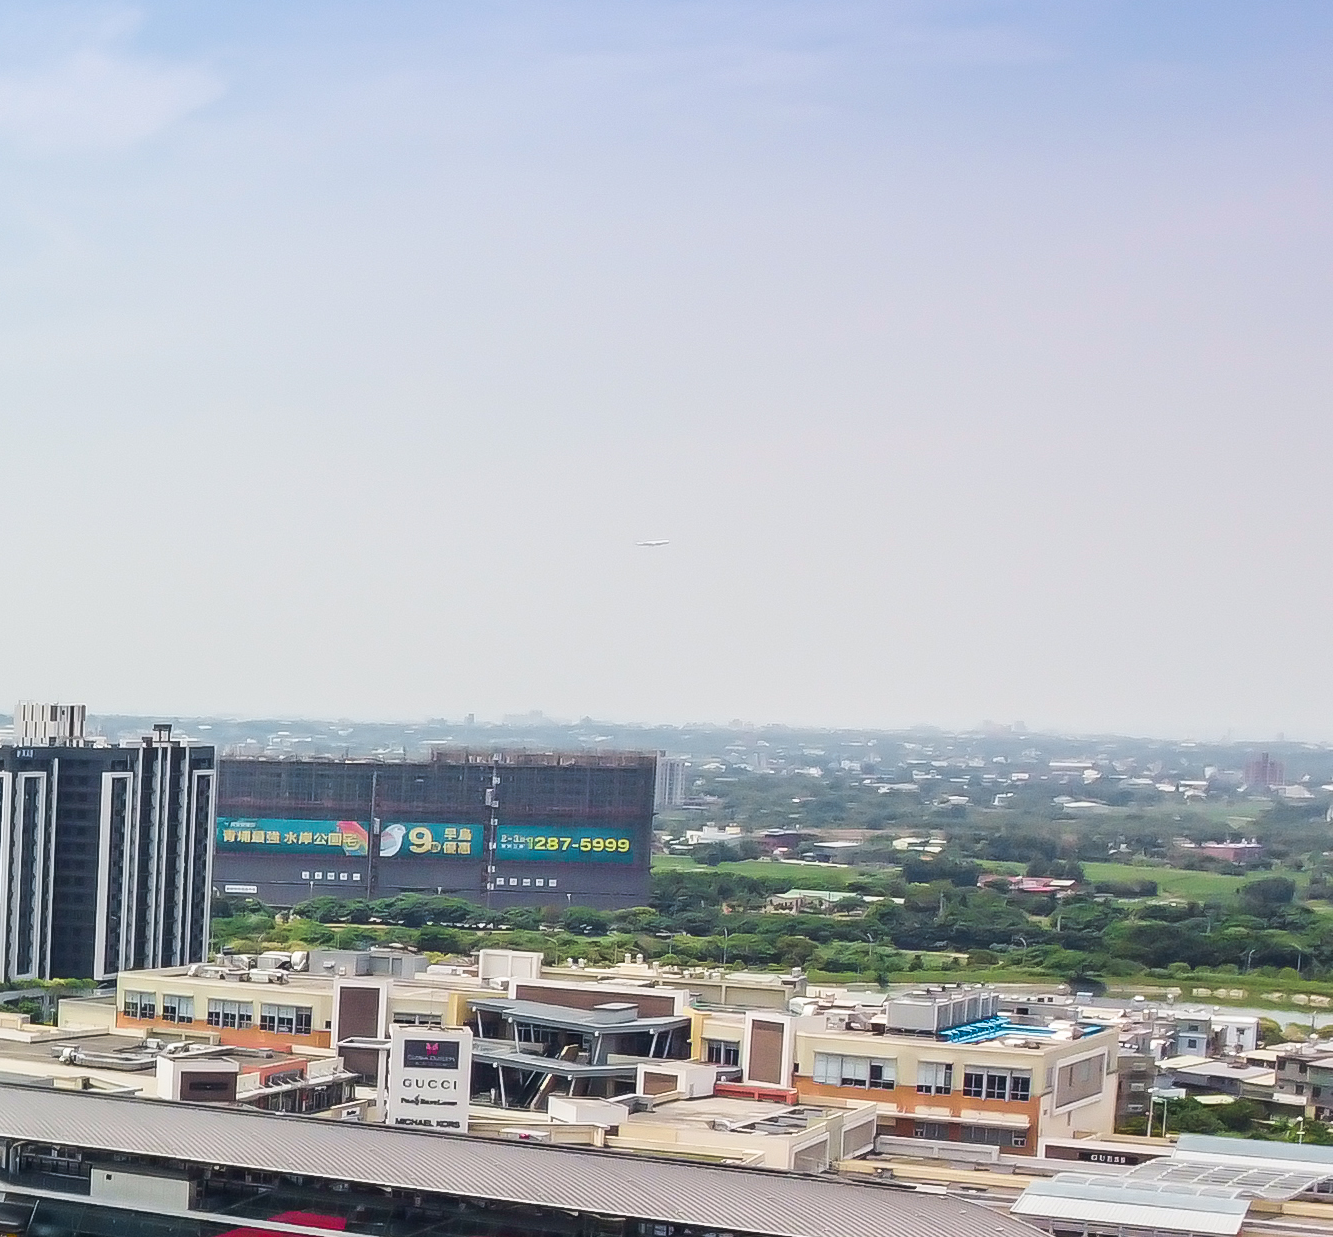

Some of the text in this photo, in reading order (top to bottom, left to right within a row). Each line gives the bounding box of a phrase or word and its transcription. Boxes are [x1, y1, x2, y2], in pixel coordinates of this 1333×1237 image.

[403, 1078, 457, 1090] GUCCI
[395, 1117, 461, 1128] MICHAEL KORS
[1090, 1153, 1126, 1164] GUESS
